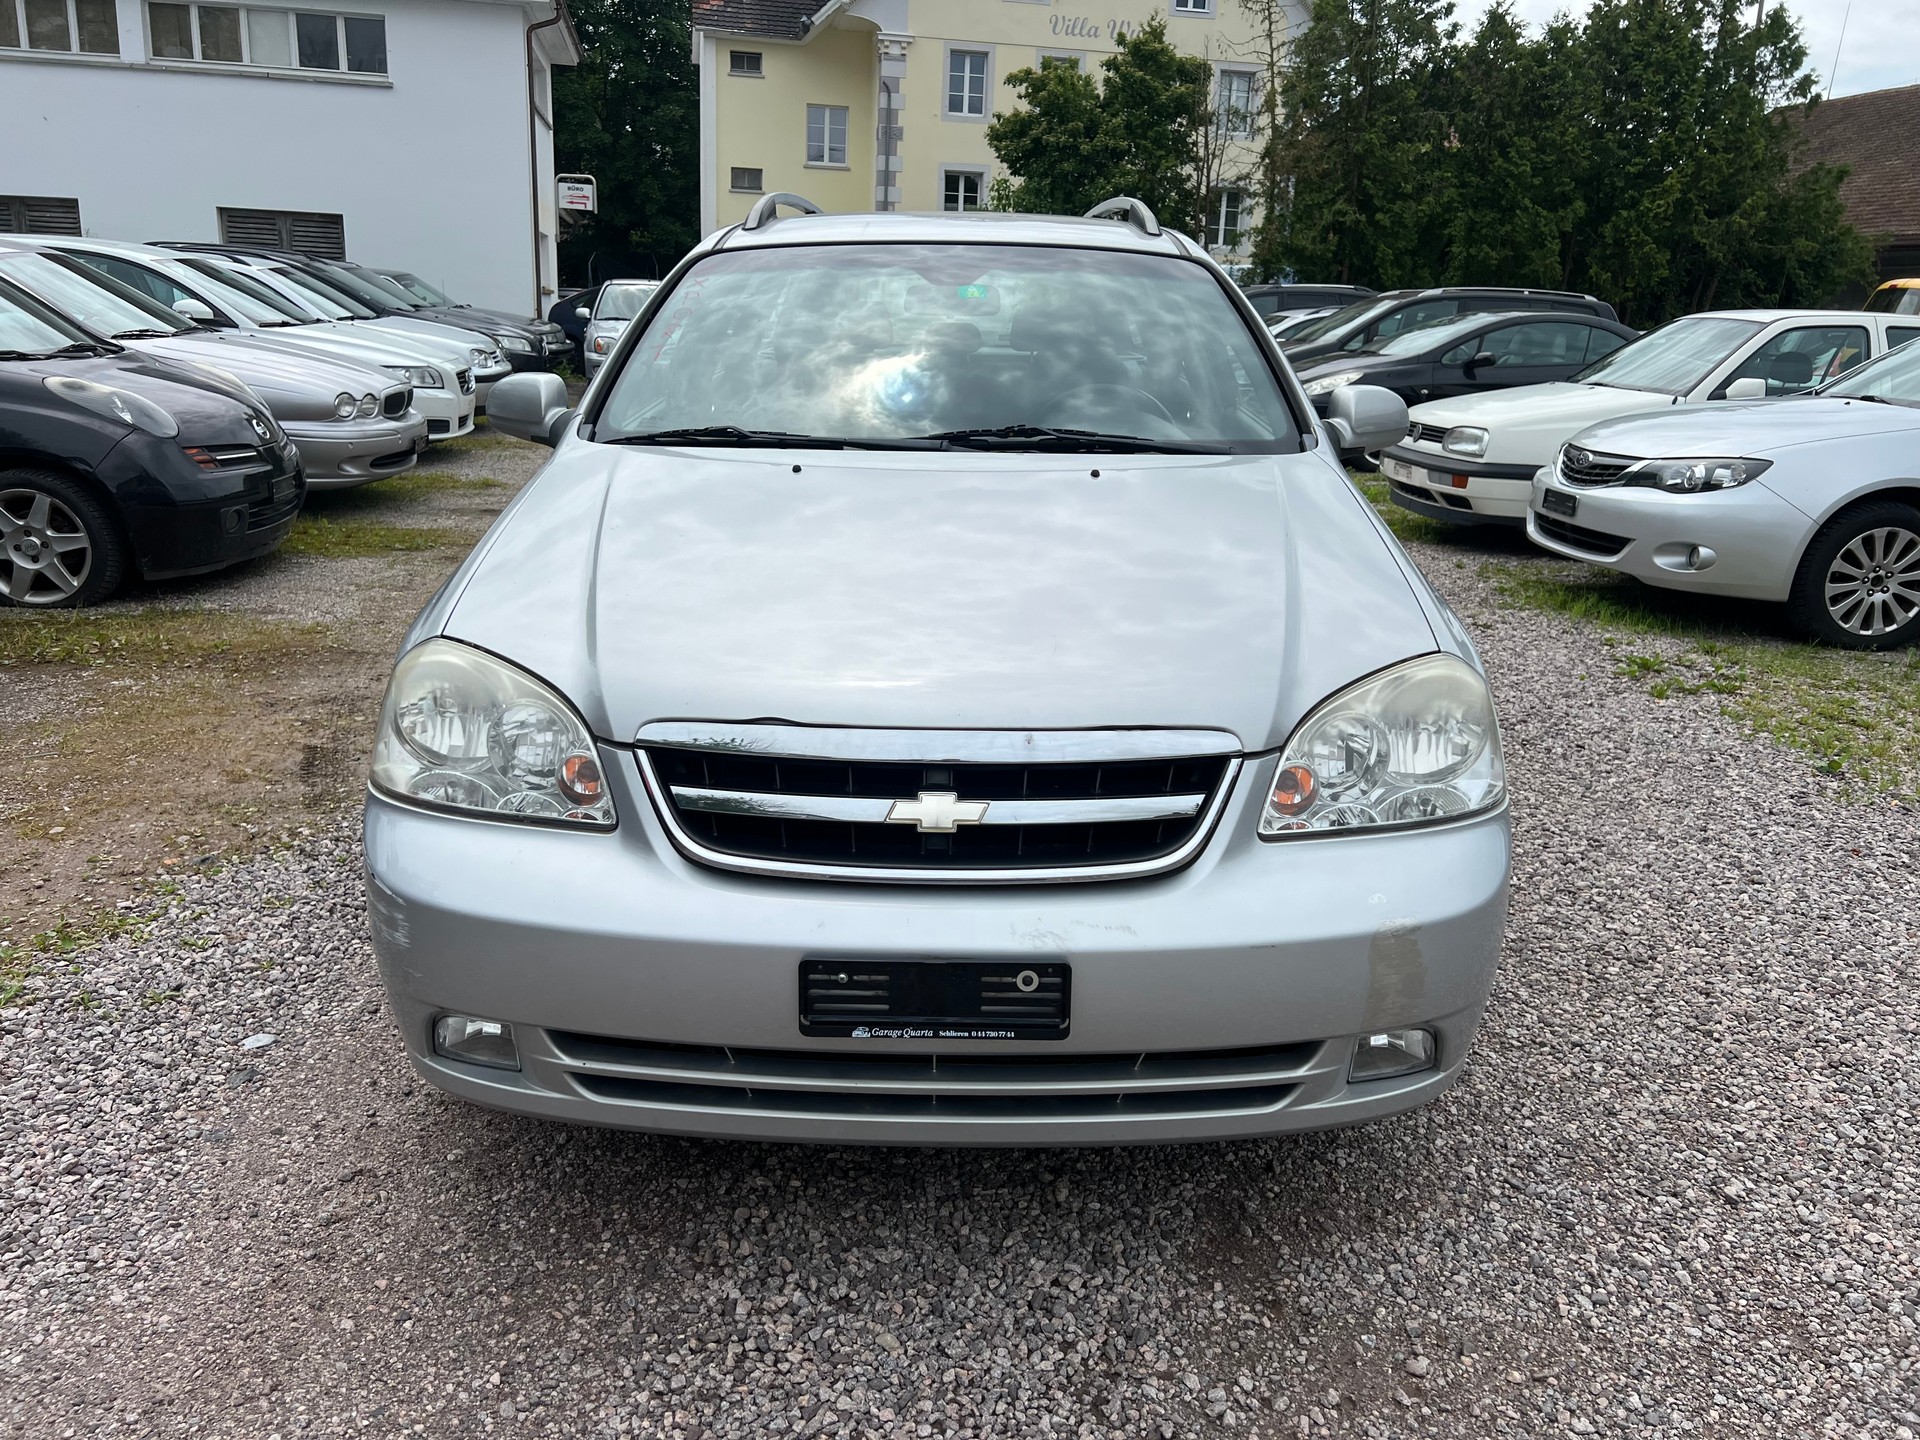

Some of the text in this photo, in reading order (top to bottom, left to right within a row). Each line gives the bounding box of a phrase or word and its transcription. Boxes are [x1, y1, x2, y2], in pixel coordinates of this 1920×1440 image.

[1049, 14, 1100, 39] Villa
[871, 1027, 902, 1038] Garage
[903, 1027, 933, 1039] Quarta
